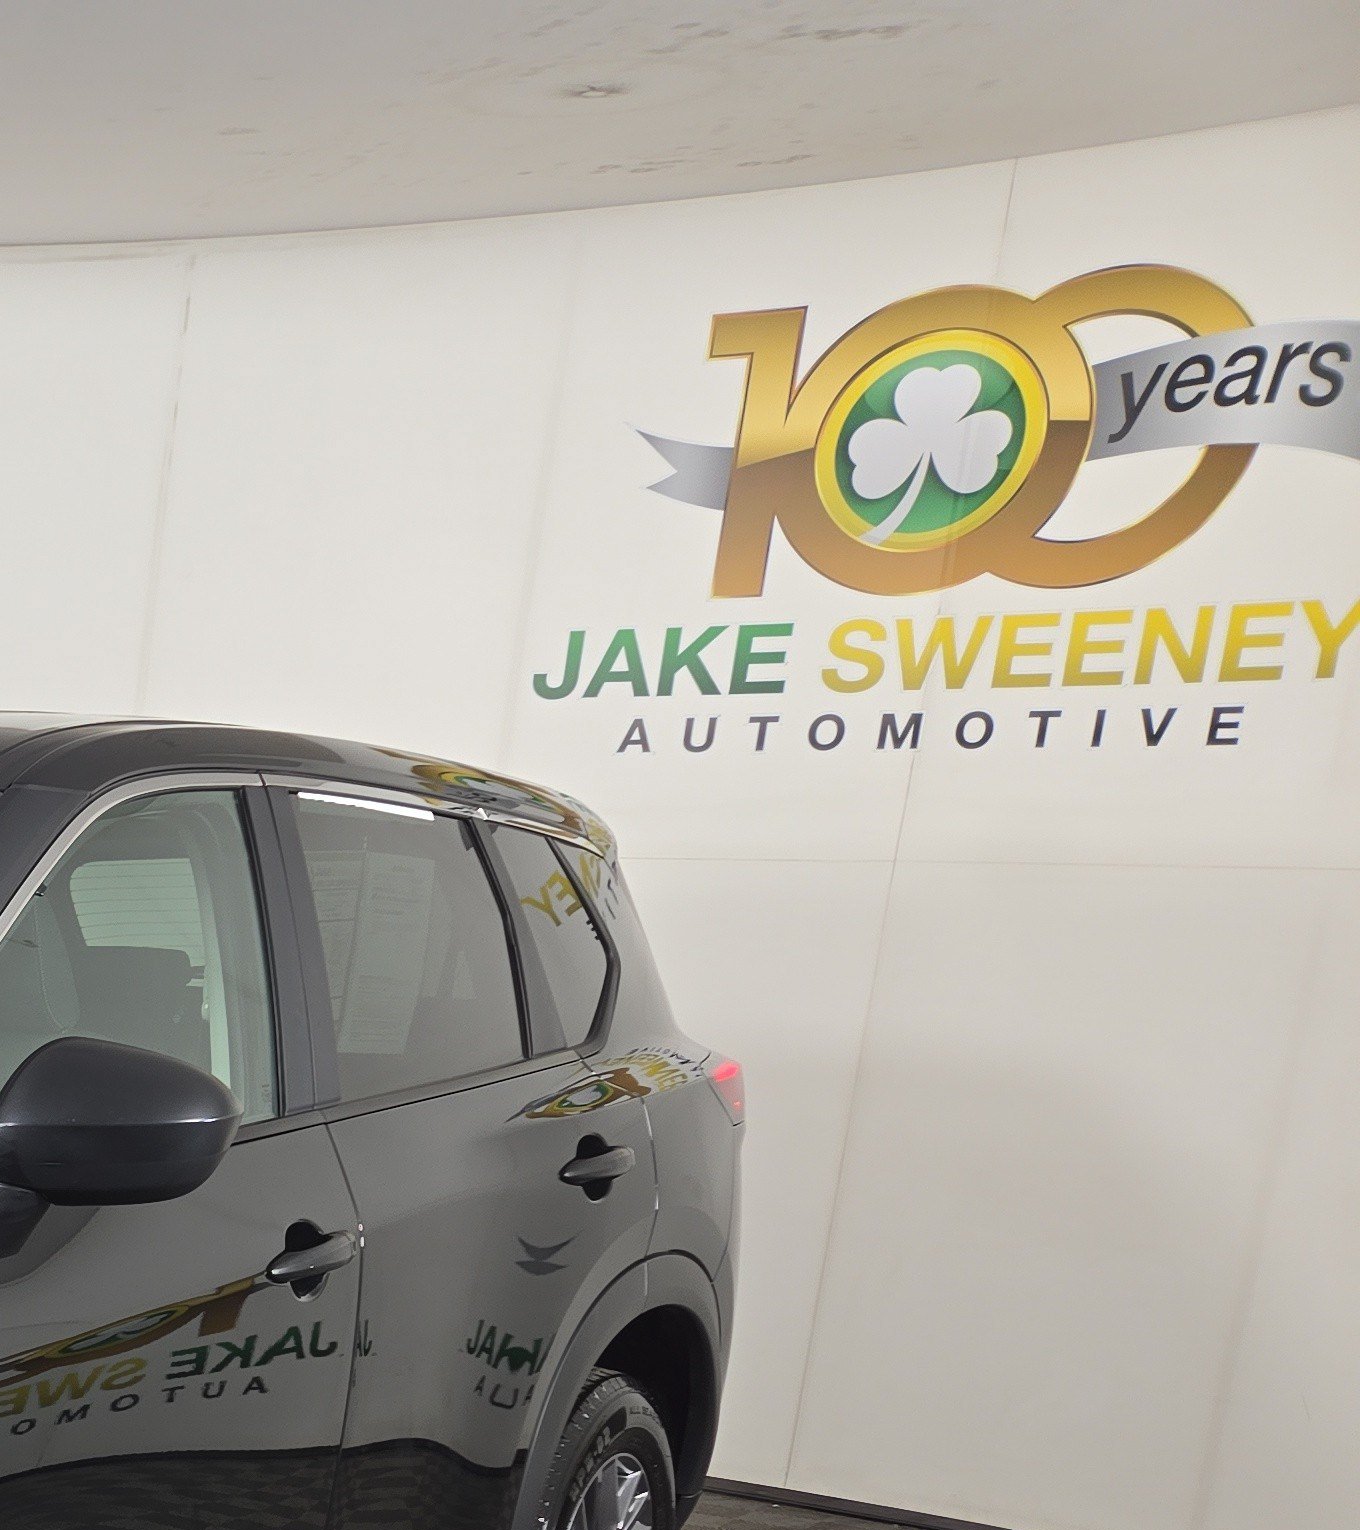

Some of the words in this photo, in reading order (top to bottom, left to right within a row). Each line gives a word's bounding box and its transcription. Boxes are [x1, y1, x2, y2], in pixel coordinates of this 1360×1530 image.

[707, 263, 1260, 598] 100
[1107, 338, 1351, 443] years
[532, 623, 794, 699] JAKE
[821, 596, 1360, 694] SWEENEY
[617, 706, 1244, 753] AUTOMOTIVE
